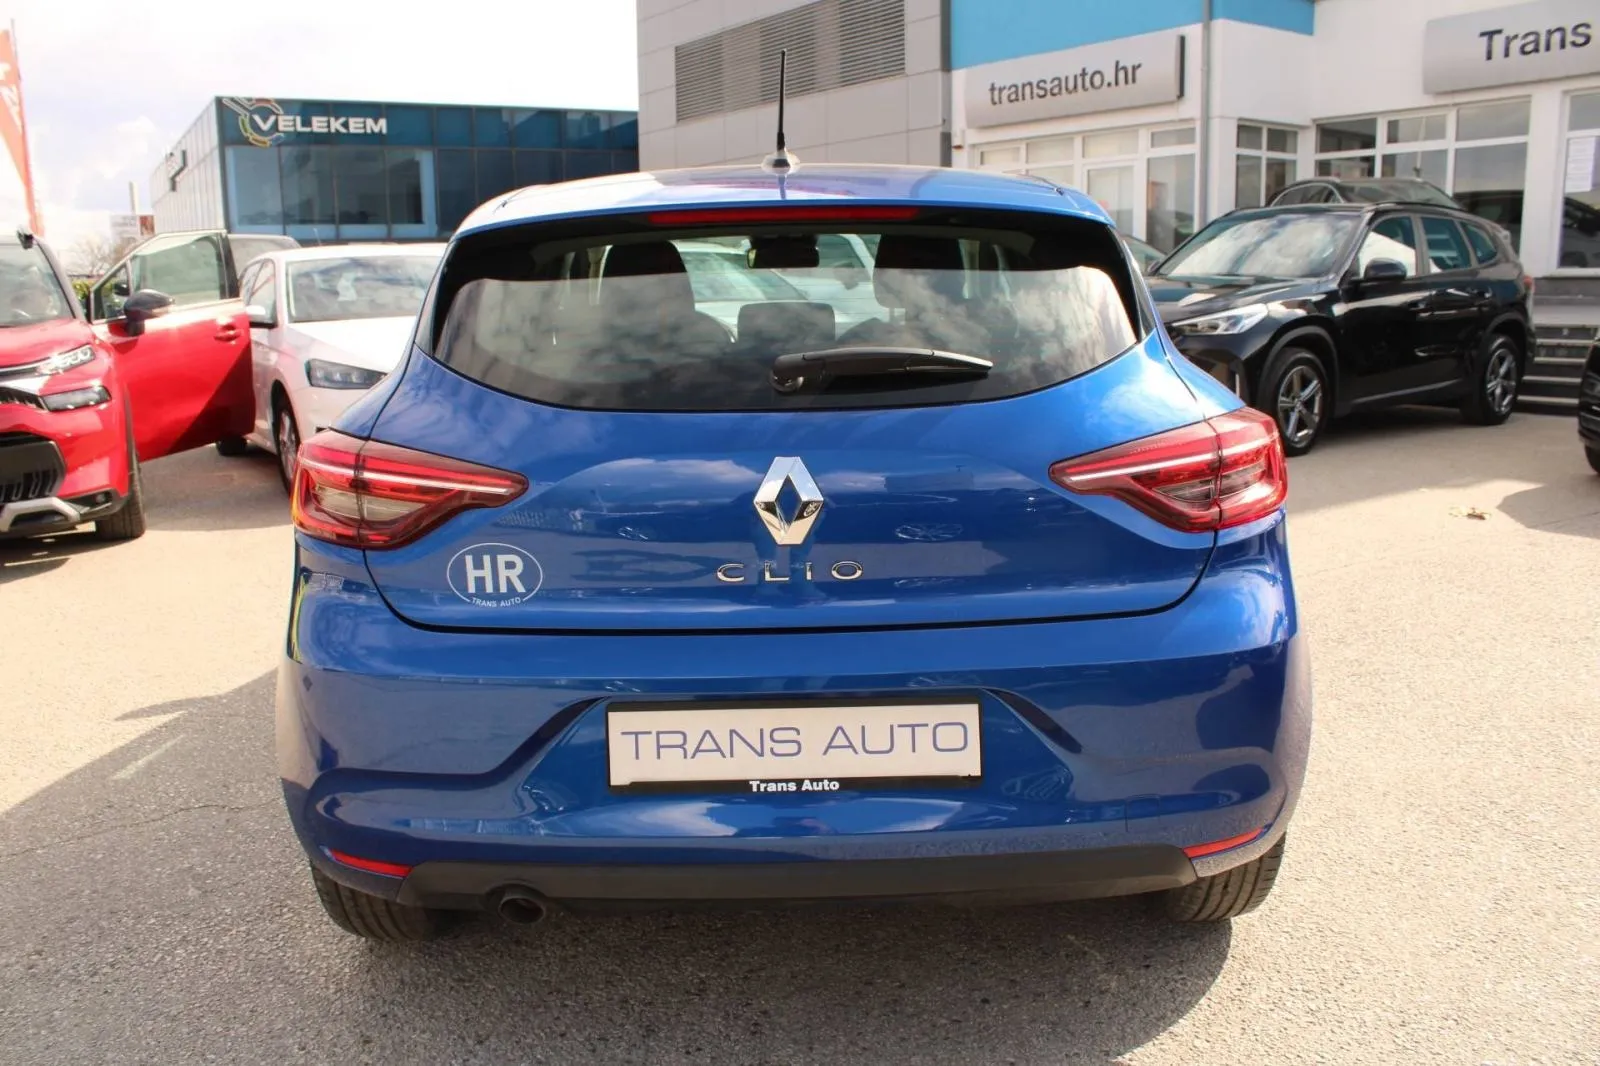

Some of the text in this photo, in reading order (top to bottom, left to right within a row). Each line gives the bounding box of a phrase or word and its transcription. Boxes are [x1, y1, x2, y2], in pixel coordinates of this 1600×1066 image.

[1478, 22, 1592, 61] Trans
[989, 60, 1142, 106] transauto.hr
[252, 114, 388, 135] VELEKEM
[465, 554, 527, 594] HR
[716, 560, 863, 583] CLIO
[472, 597, 522, 608] TRANS AUTO
[620, 721, 969, 761] TRANS AUTO
[749, 779, 841, 793] Trans Auto
